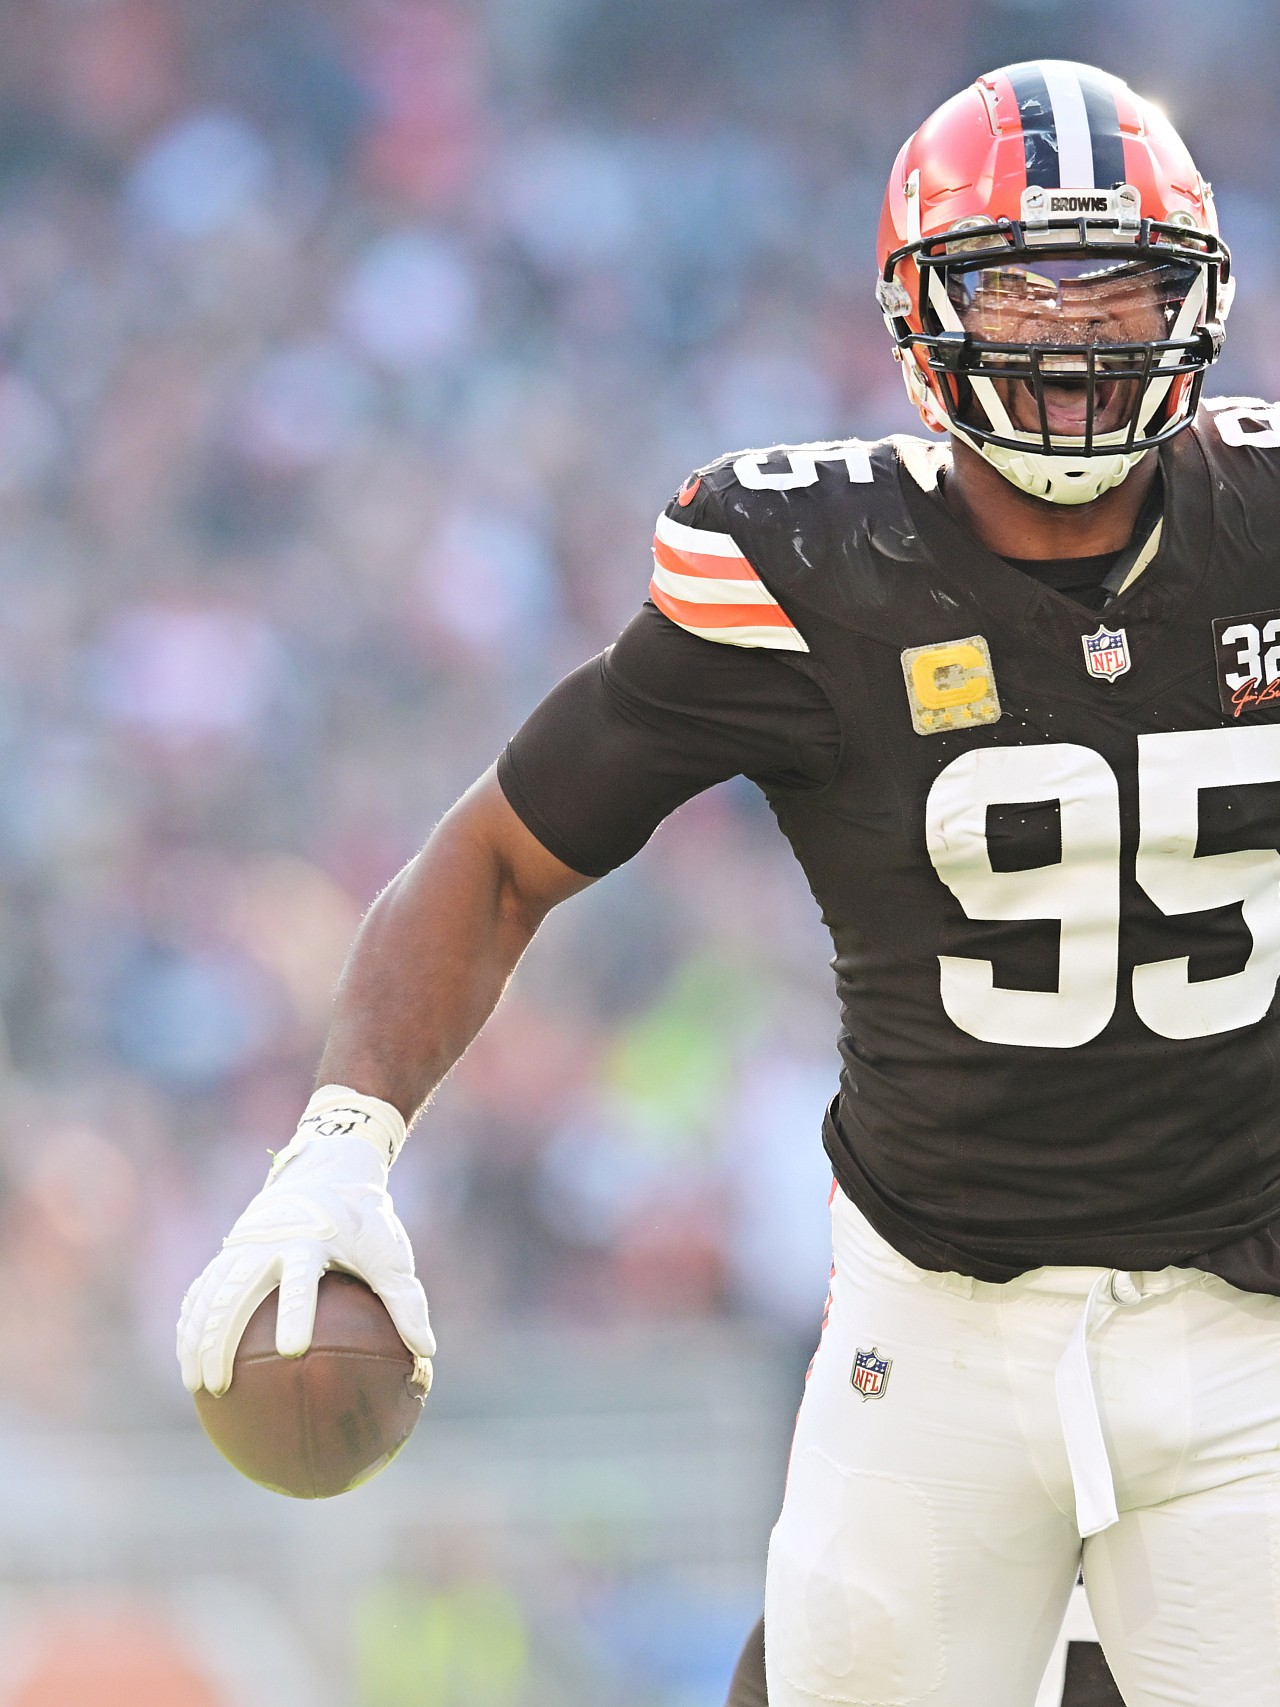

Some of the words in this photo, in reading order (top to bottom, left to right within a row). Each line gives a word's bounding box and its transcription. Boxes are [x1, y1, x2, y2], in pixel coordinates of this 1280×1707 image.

[1050, 197, 1108, 212] BROWNS
[1092, 650, 1124, 673] NFL
[911, 645, 989, 710] C
[854, 1367, 879, 1392] NFL
